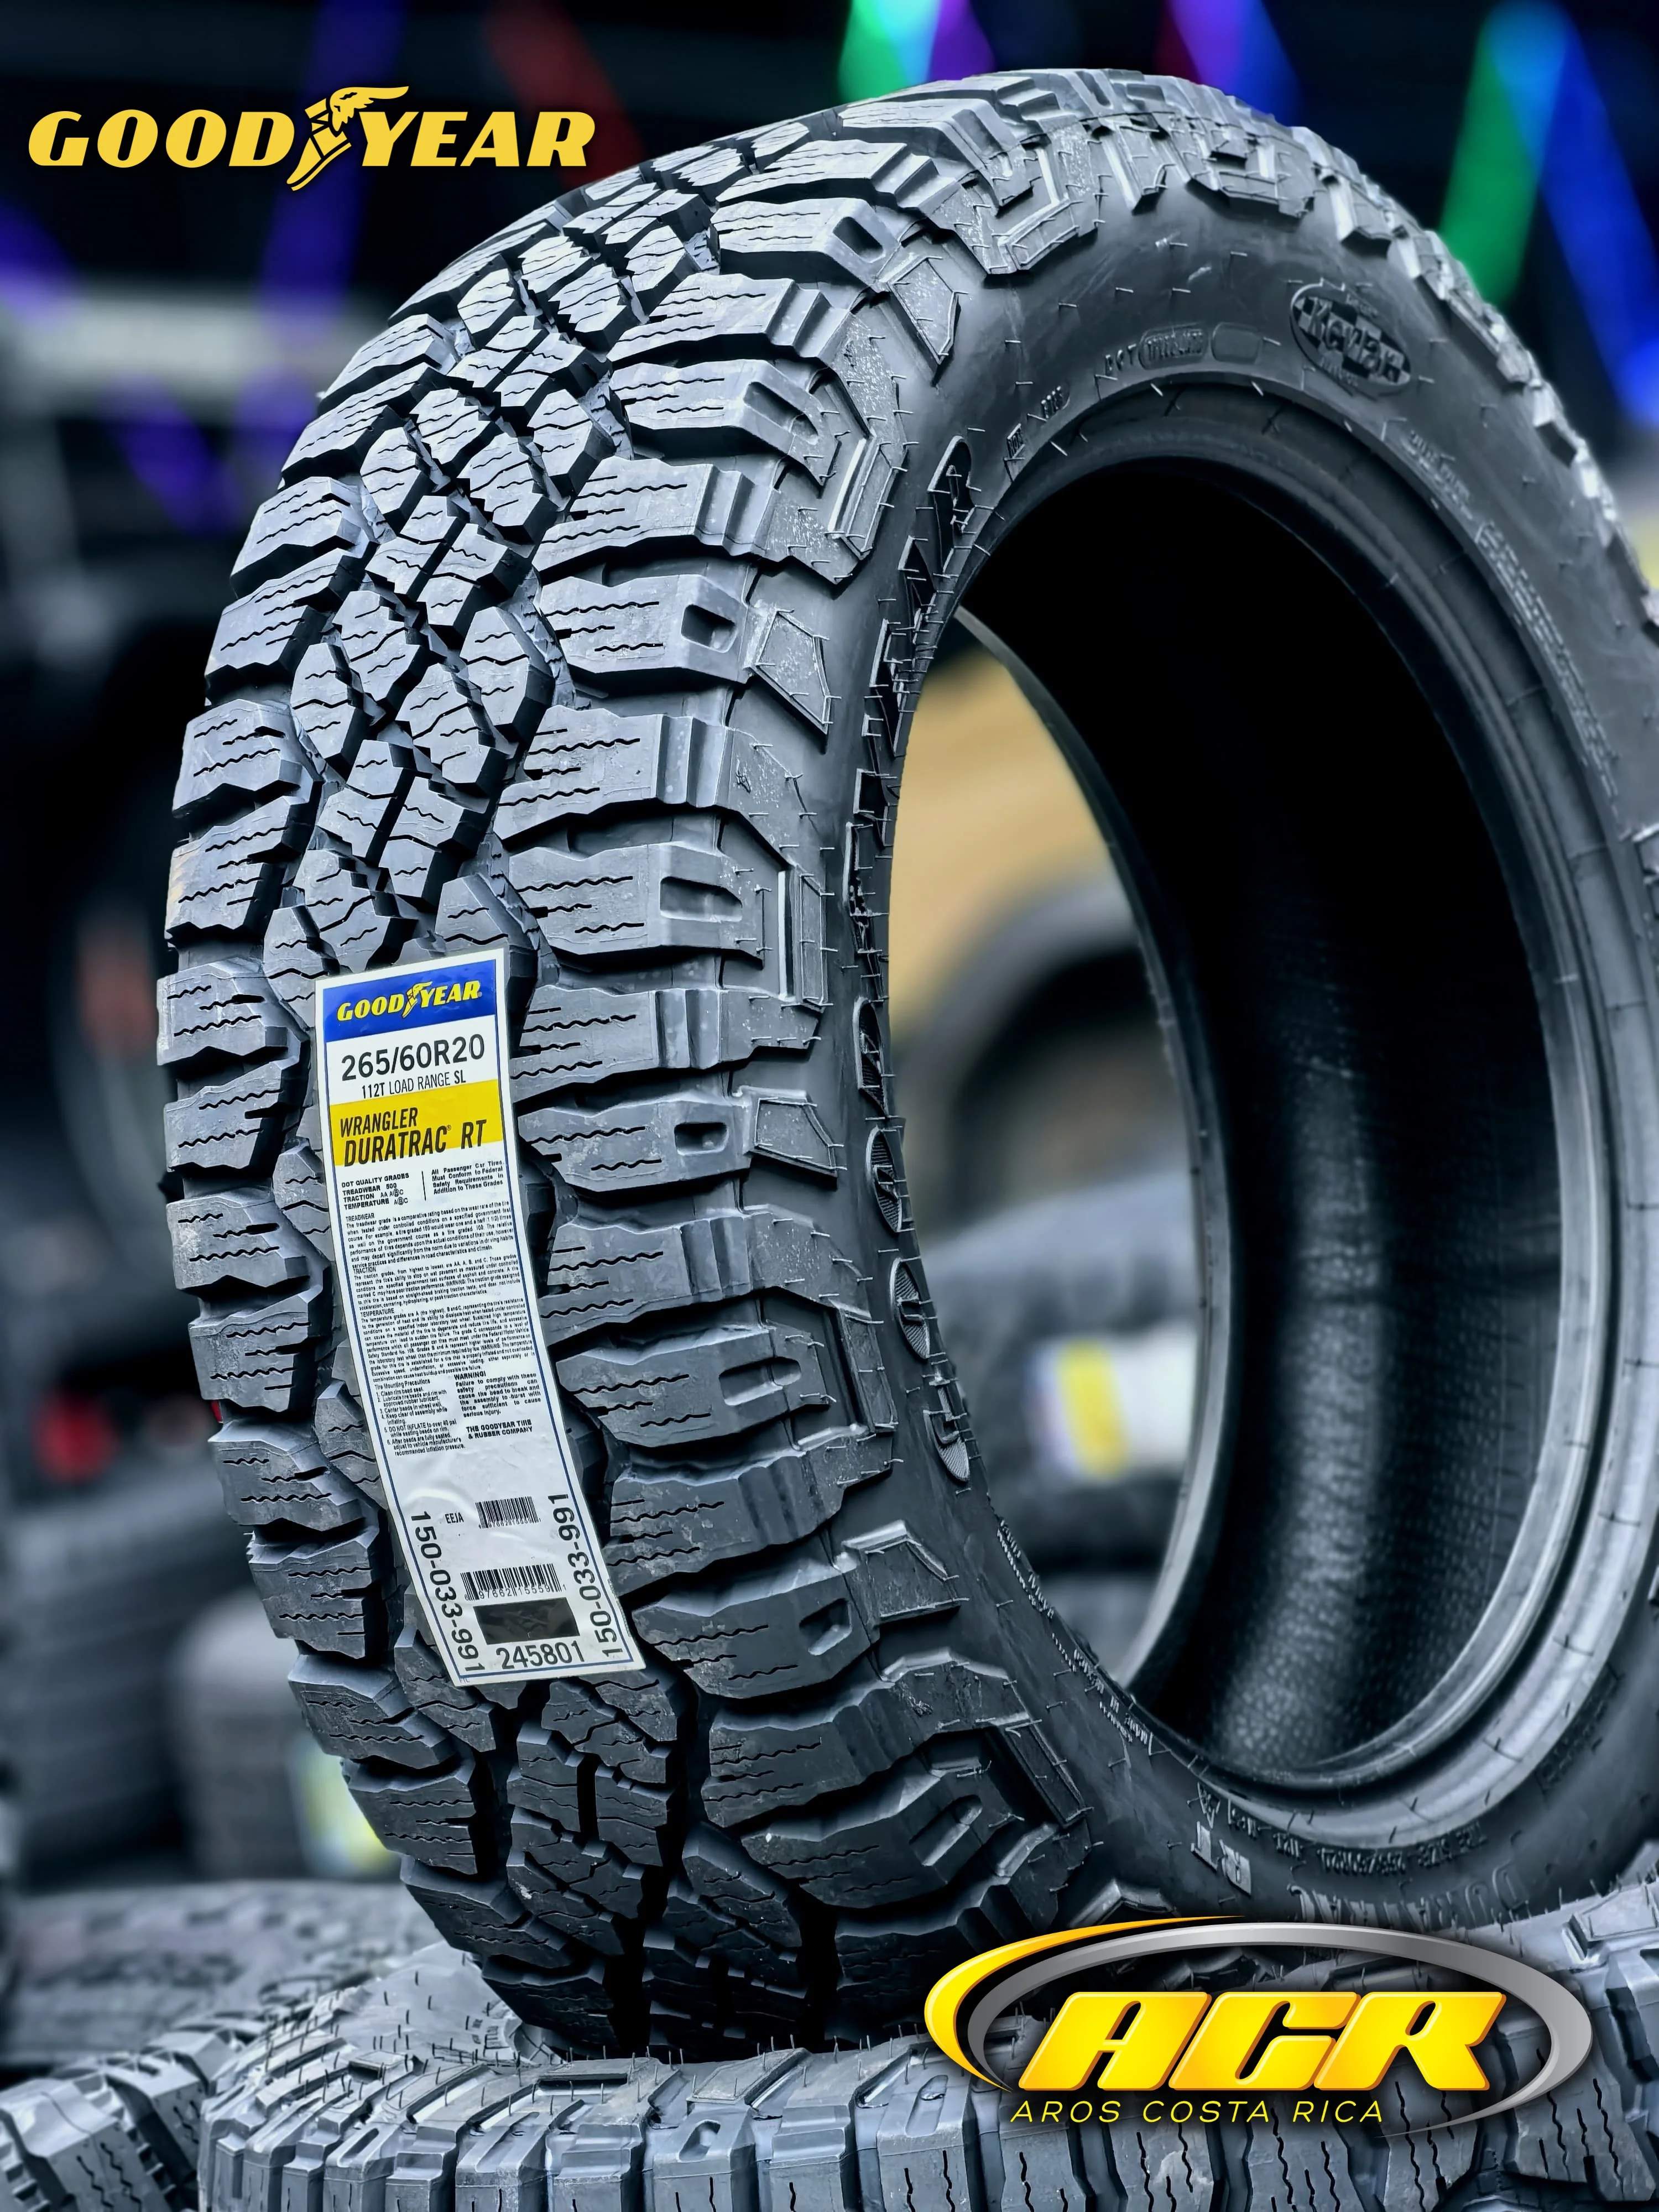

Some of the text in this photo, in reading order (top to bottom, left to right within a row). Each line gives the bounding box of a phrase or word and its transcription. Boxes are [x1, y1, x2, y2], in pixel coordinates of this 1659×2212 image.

[342, 1033, 485, 1081] 265/60R20
[361, 1071, 466, 1099] 112T LOAD RANGE SL
[340, 1107, 419, 1139] WRANGLER
[461, 1119, 487, 1150] RT
[342, 1185, 380, 1196] TREADWEAR
[355, 1176, 382, 1186] QUALITY
[384, 1172, 409, 1181] GRADES
[474, 1430, 500, 1438] RUBBER
[501, 1426, 533, 1435] COMPANY
[445, 1512, 464, 1524] EEJA
[547, 1494, 623, 1657] 150-033-991
[411, 1511, 486, 1672] 150-033-991
[495, 1640, 585, 1670] 245801
